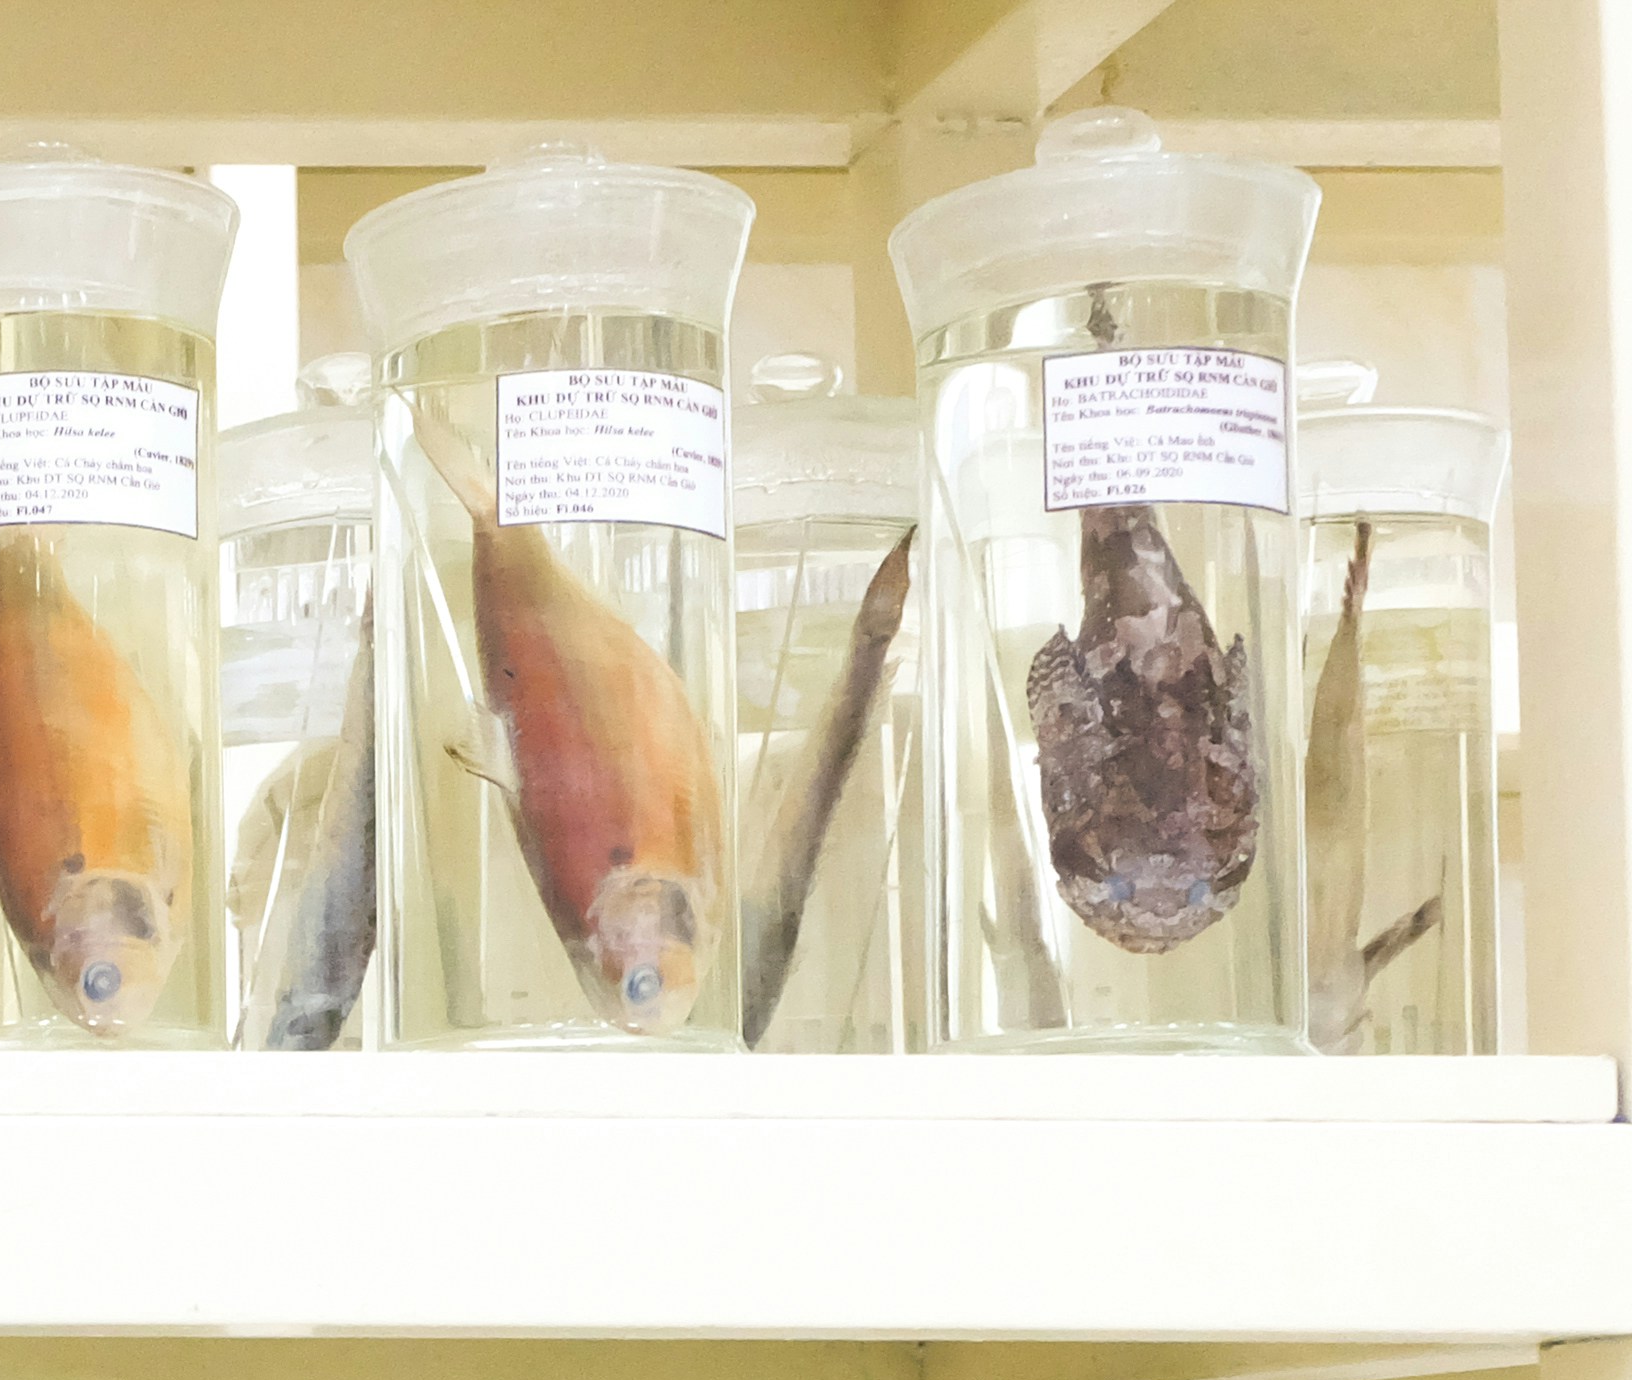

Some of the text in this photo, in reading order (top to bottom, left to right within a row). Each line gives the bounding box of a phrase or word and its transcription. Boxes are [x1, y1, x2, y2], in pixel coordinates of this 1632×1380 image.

[1199, 372, 1230, 384] RNM
[82, 396, 100, 406] SQ
[105, 397, 136, 408] RNM
[517, 396, 551, 407] KHU
[621, 392, 639, 405] SQ
[644, 395, 673, 408] RNM
